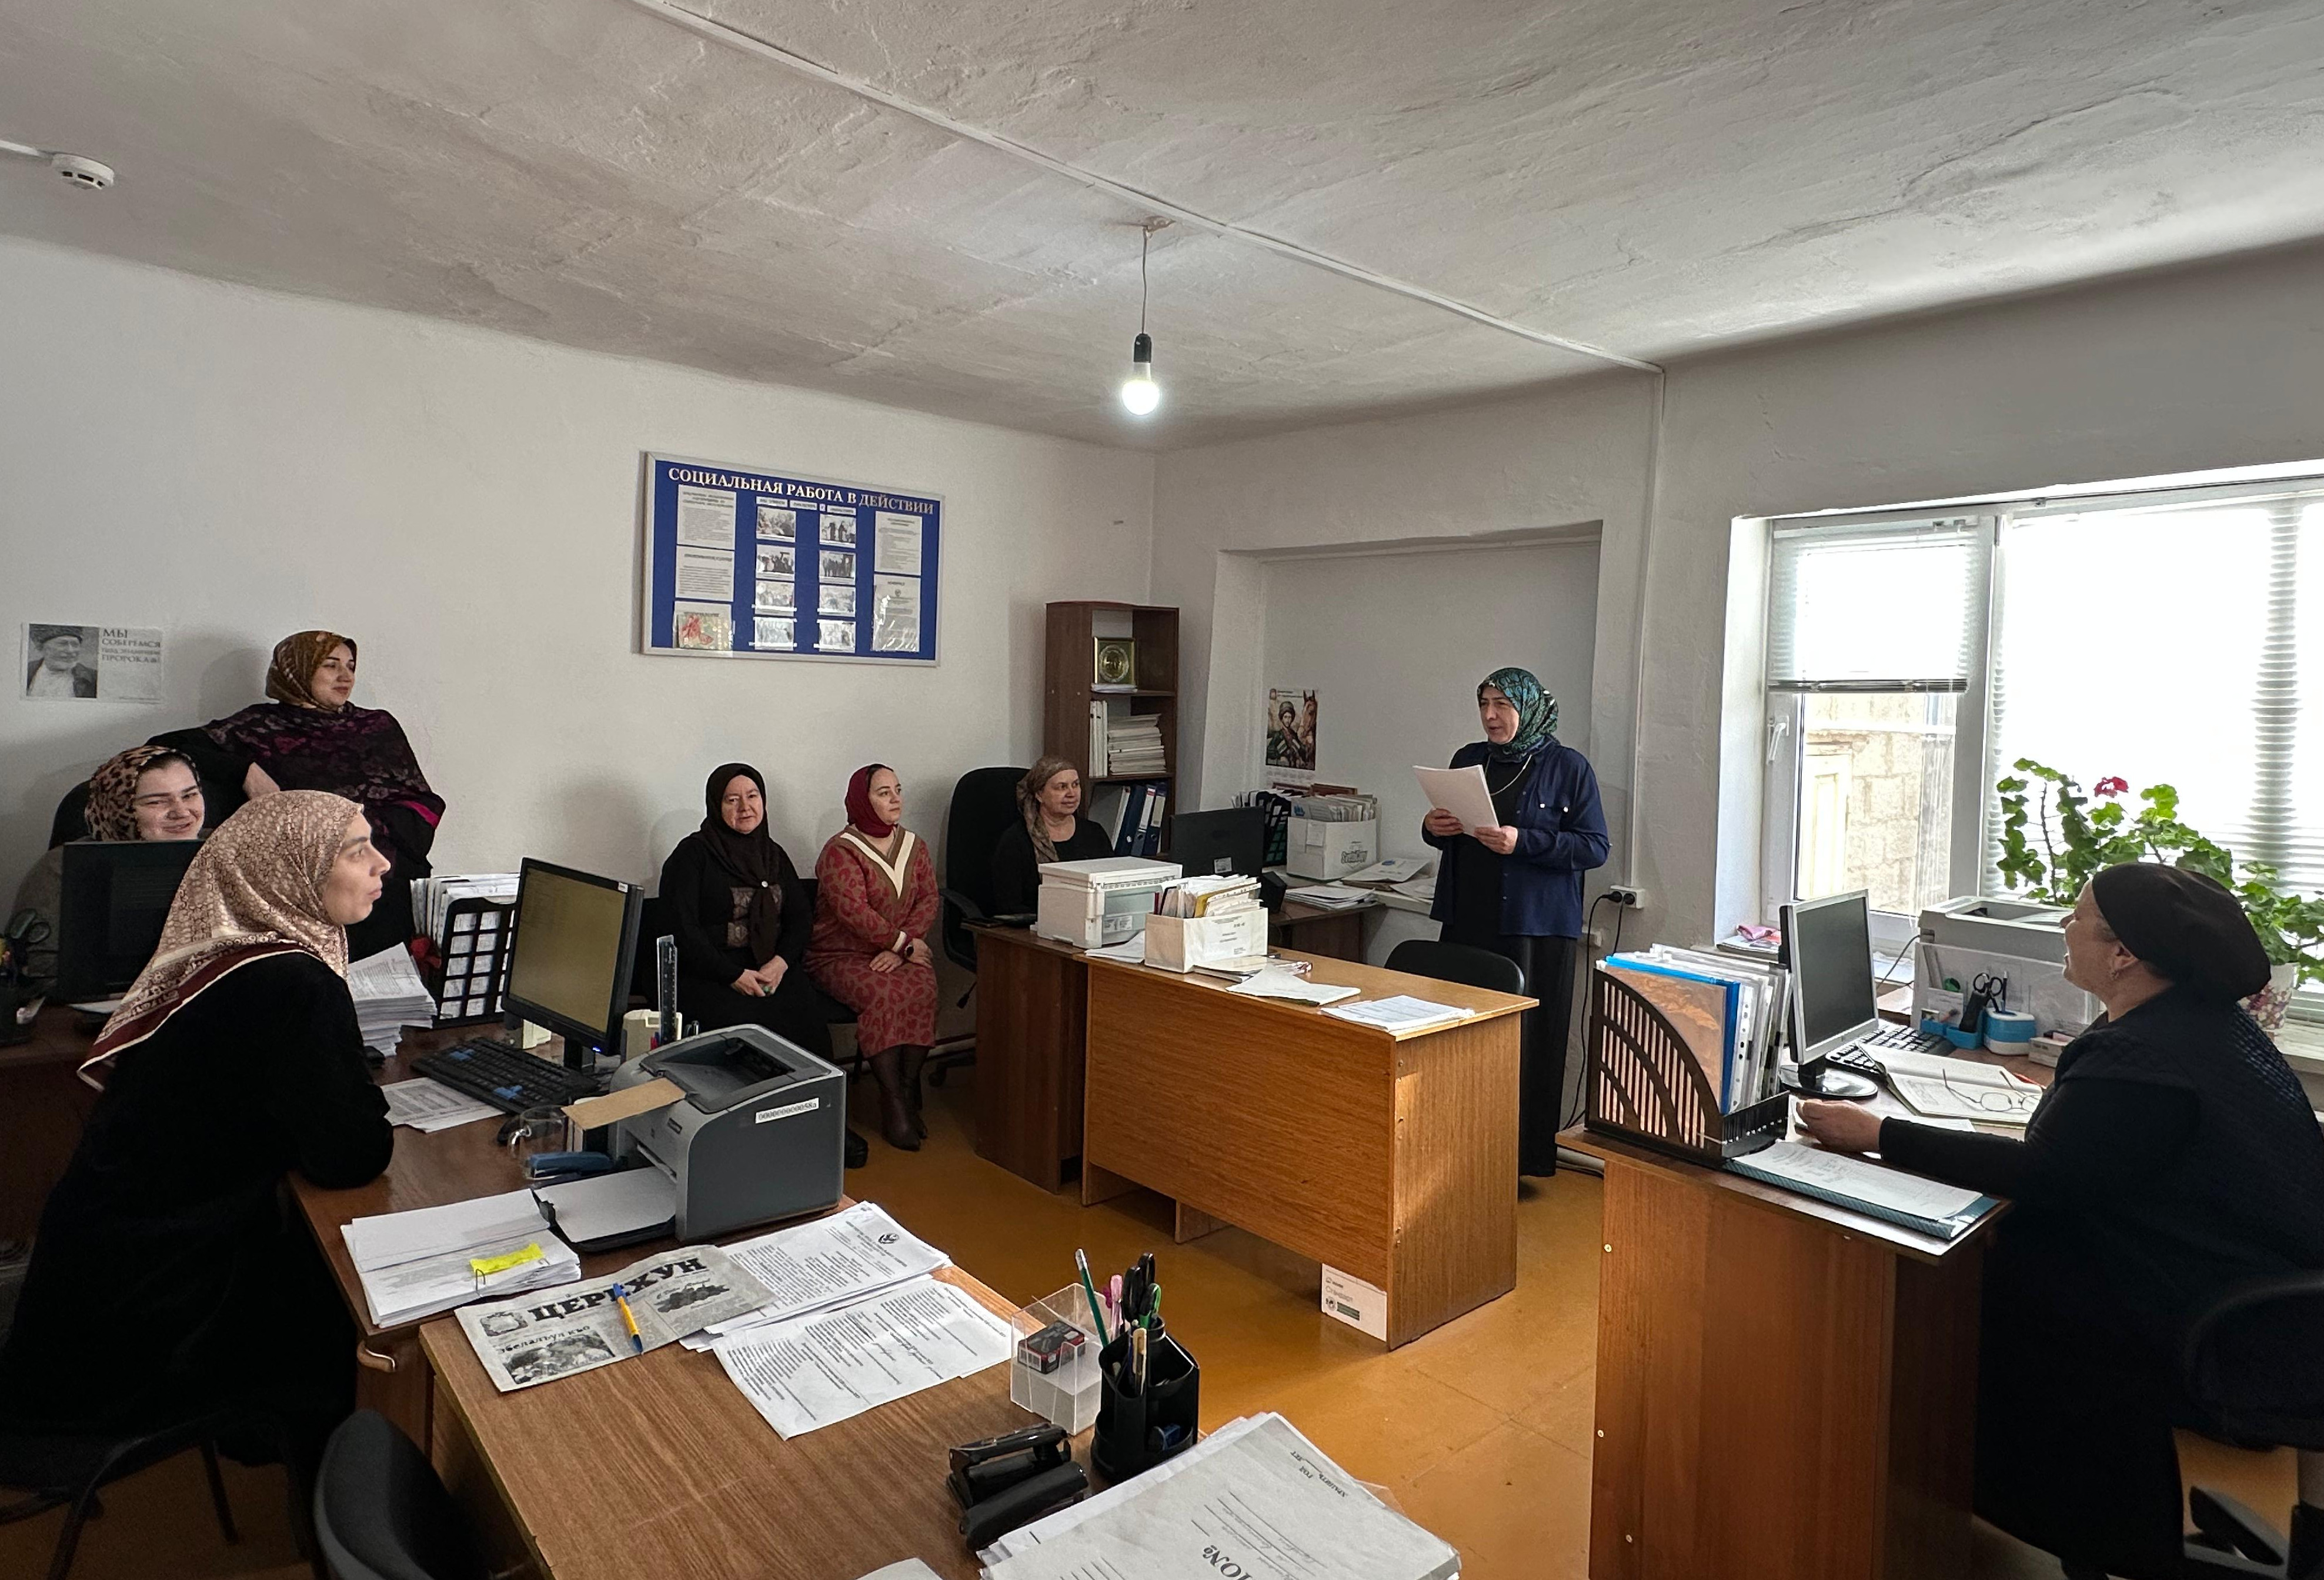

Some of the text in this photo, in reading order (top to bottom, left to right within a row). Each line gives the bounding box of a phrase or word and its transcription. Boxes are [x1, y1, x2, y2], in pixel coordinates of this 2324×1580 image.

[668, 467, 934, 515] СОЦИАЛЬНАЯ РАБОТА В ДЕЙСТВИИ
[103, 629, 128, 638] МЫ
